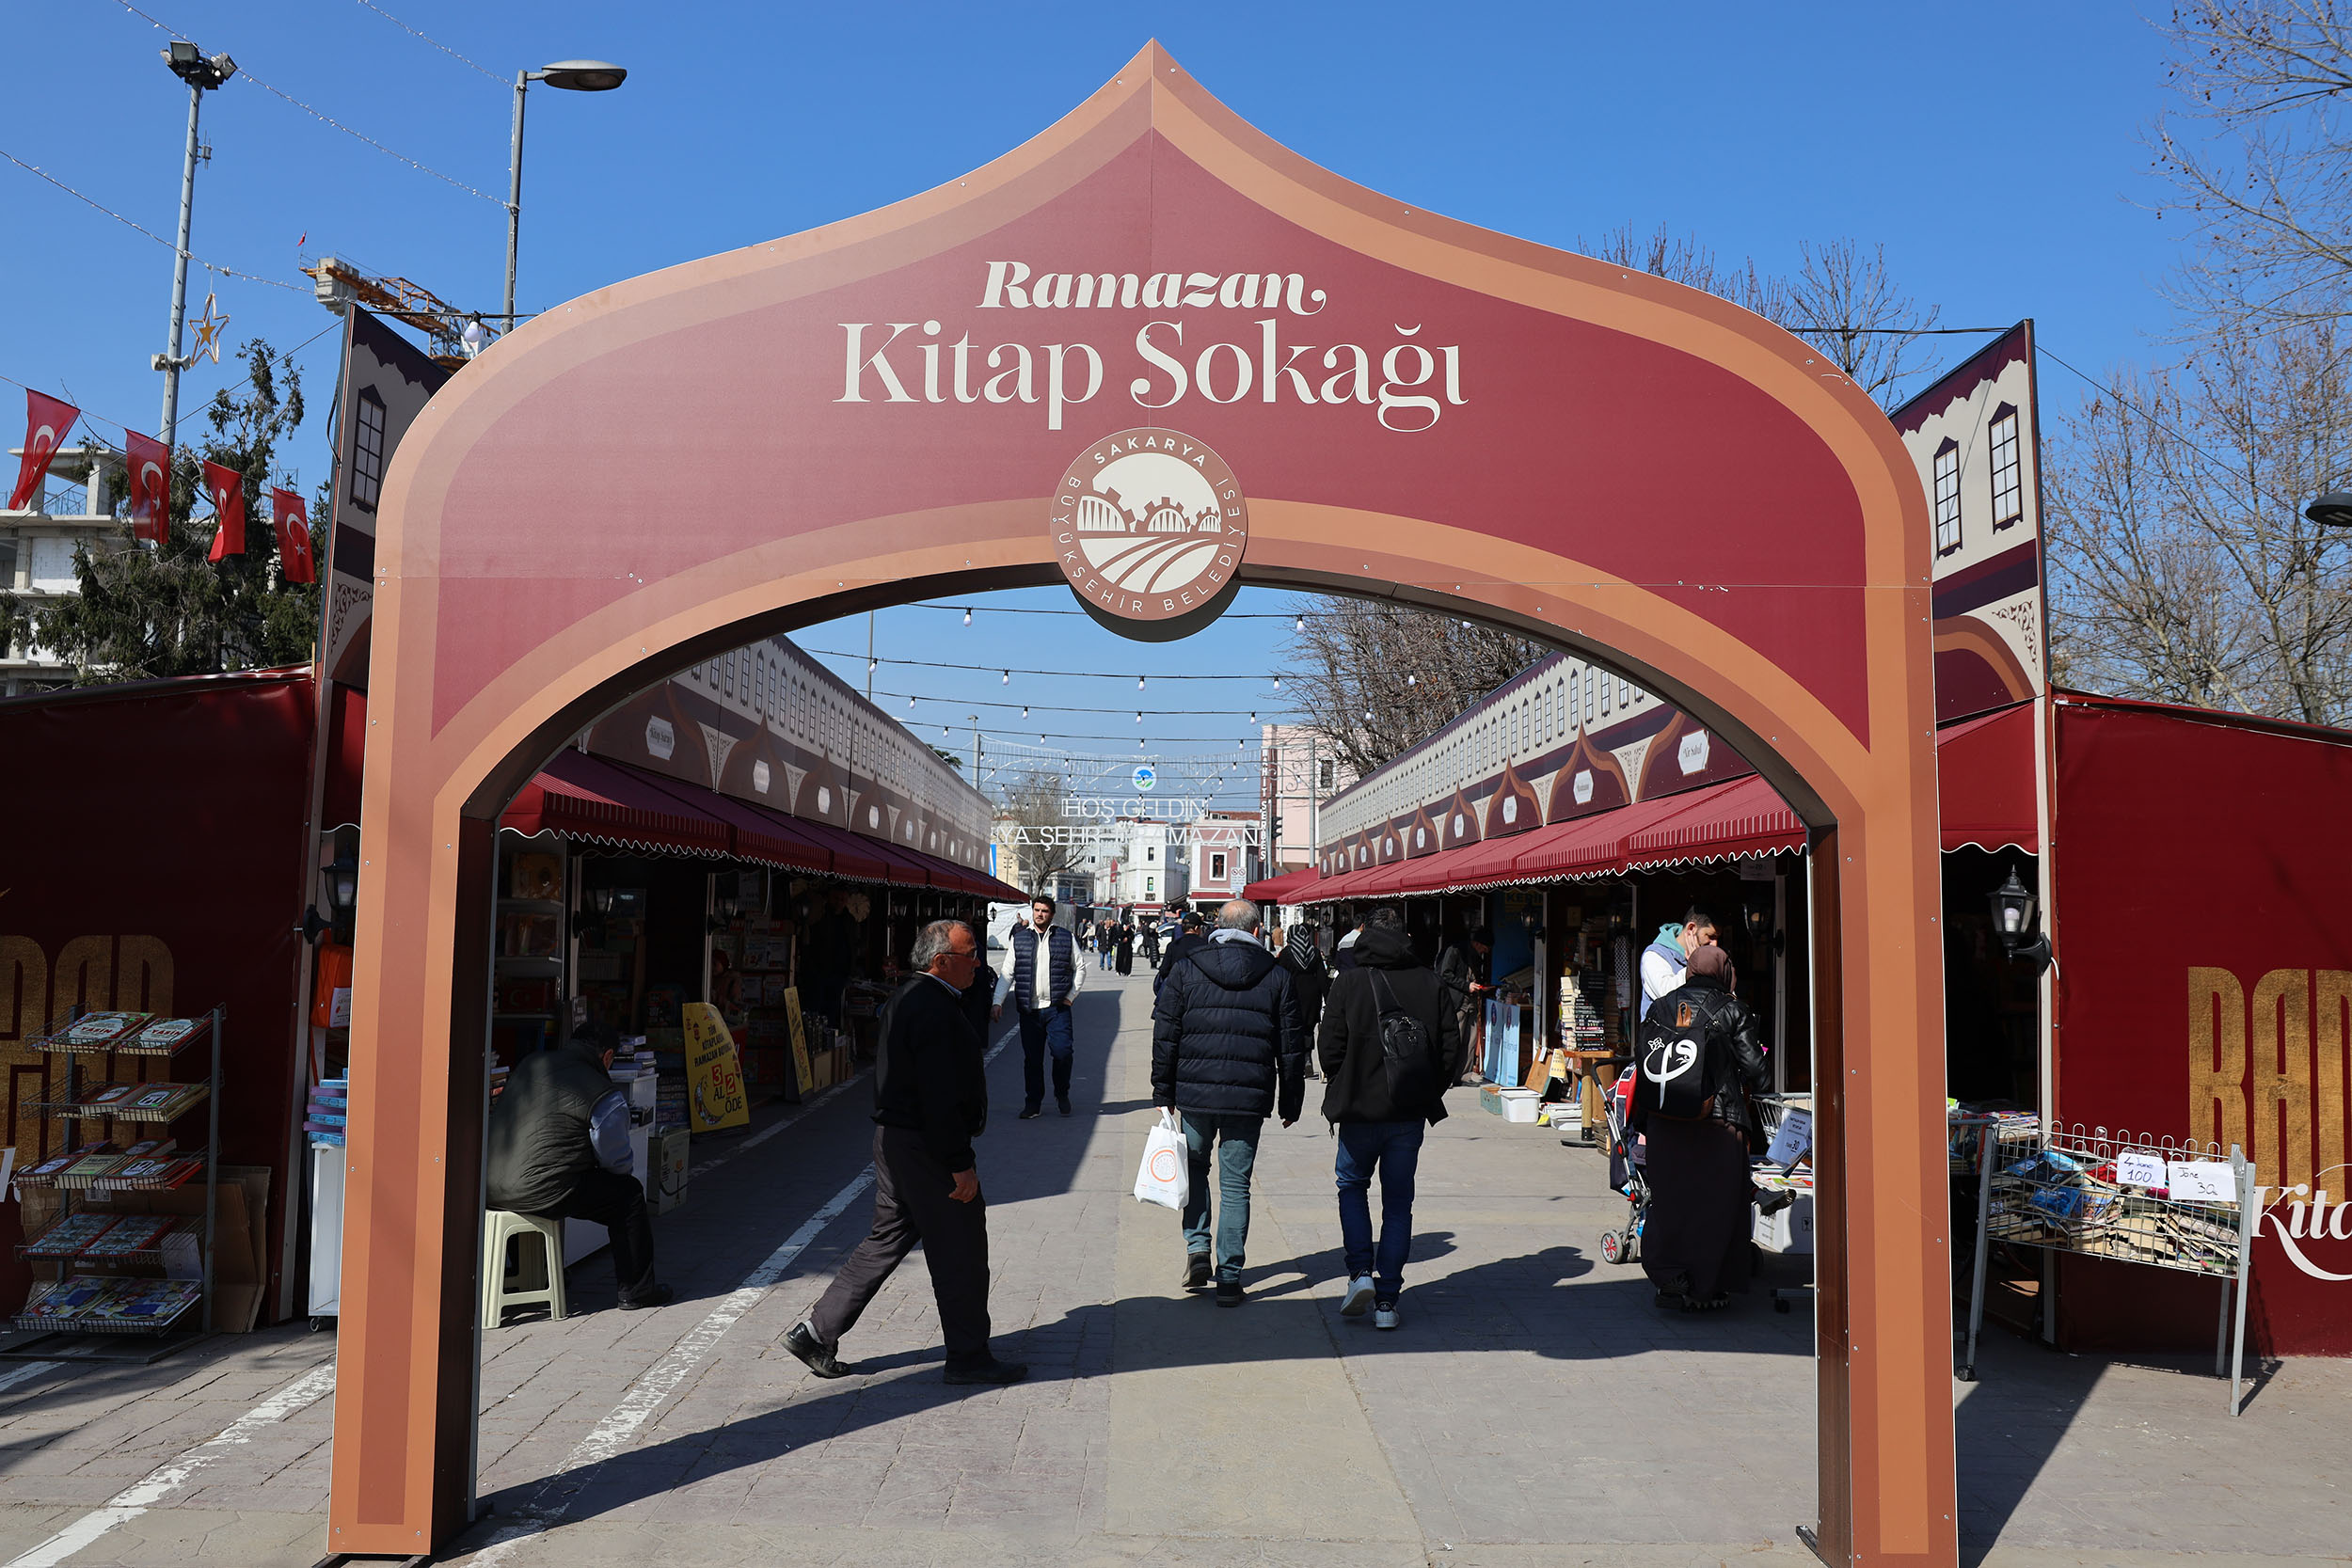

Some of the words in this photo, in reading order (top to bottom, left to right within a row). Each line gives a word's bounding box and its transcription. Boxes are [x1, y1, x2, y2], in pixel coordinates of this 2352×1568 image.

[975, 261, 1327, 315] Ramazan
[832, 320, 1104, 431] Kitap
[1129, 320, 1469, 433] Sokağı
[1094, 436, 1206, 467] SAKARYA
[1057, 476, 1143, 612] BÜYÜKŞEHİR
[1163, 478, 1241, 611] BELEDİYESİ
[1064, 799, 1115, 823] HOŞ
[1123, 796, 1206, 817] GELDİN
[713, 1066, 722, 1084] 3
[725, 1074, 735, 1093] 2
[713, 1086, 724, 1101] AL
[725, 1097, 742, 1114] ÖDE
[2123, 1156, 2135, 1167] 4
